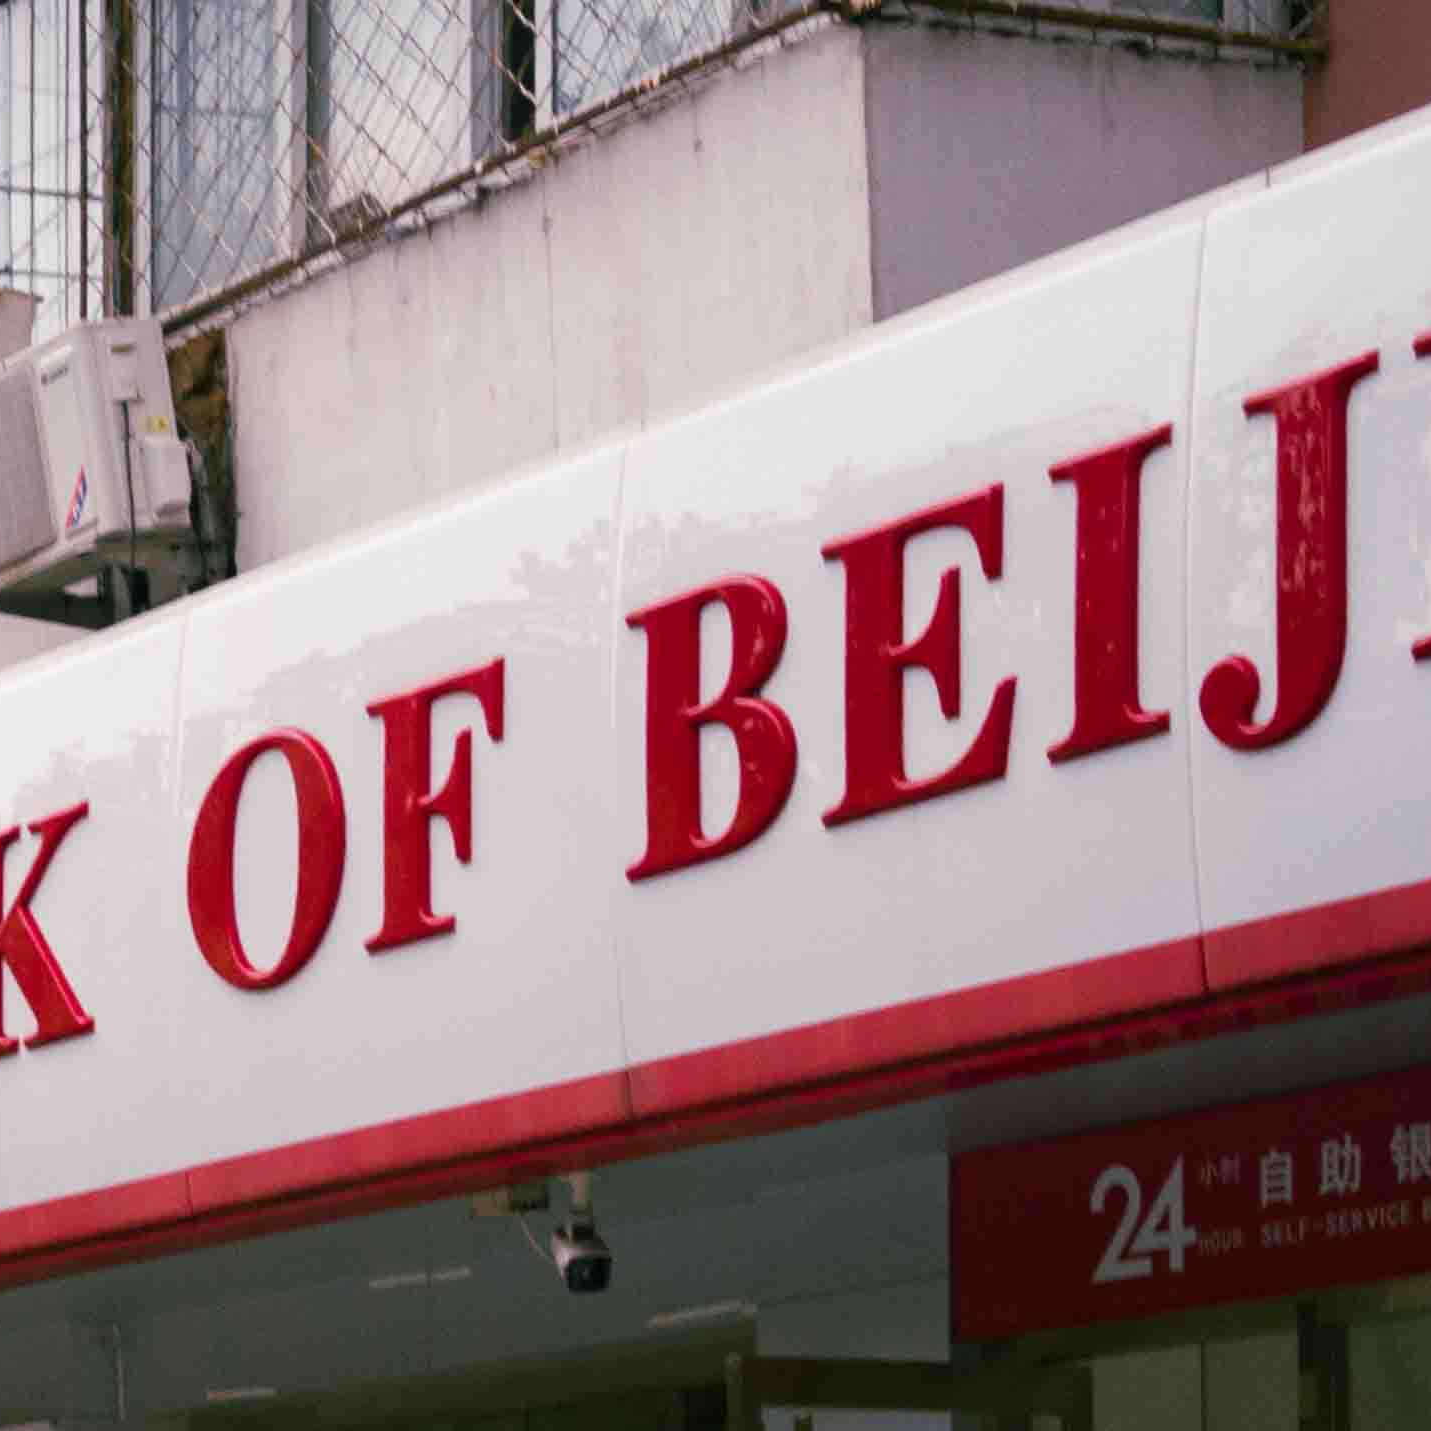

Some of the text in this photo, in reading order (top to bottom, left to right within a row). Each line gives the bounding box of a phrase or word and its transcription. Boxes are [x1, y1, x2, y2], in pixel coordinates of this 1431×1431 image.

[186, 656, 506, 993] OF
[1088, 1152, 1198, 1287] 24
[1258, 1197, 1411, 1250] SELF-SERVICE
